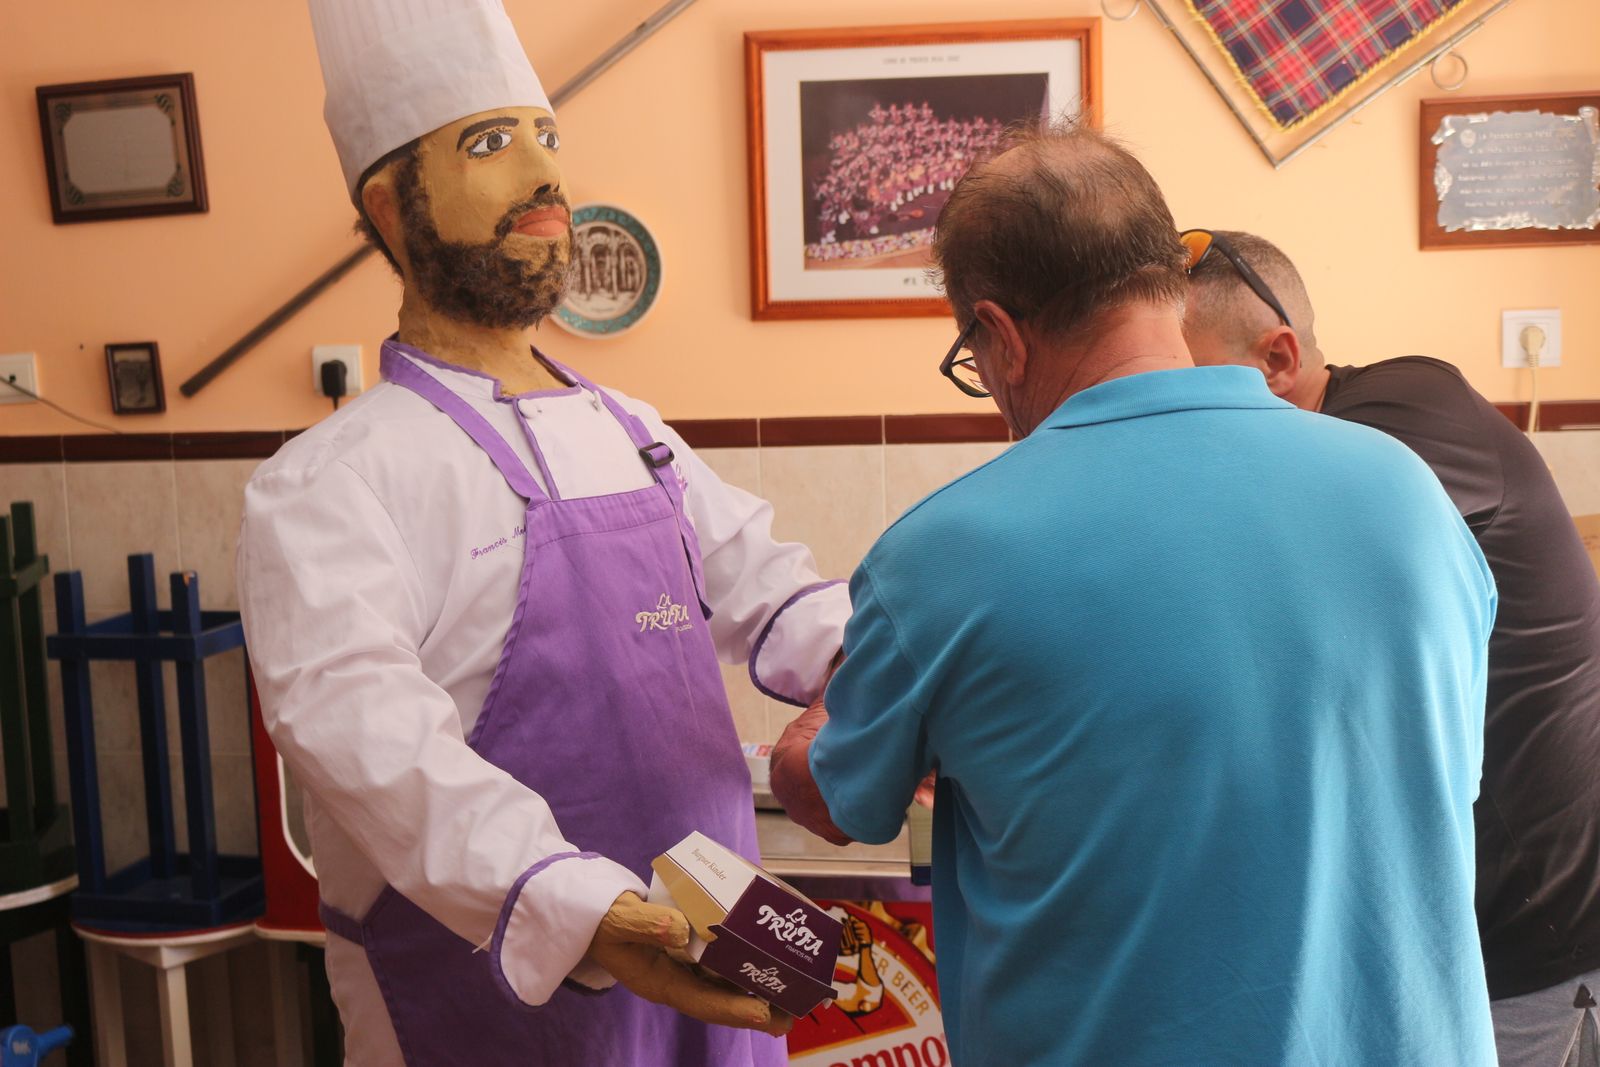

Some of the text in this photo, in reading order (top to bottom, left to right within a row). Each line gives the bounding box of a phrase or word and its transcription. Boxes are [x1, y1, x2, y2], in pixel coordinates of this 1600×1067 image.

[471, 537, 507, 560] Francis
[635, 604, 690, 632] TRUFA
[756, 904, 824, 956] TRUFA
[785, 908, 808, 925] LA
[739, 962, 787, 993] TRUFA
[892, 970, 930, 1016] BEER
